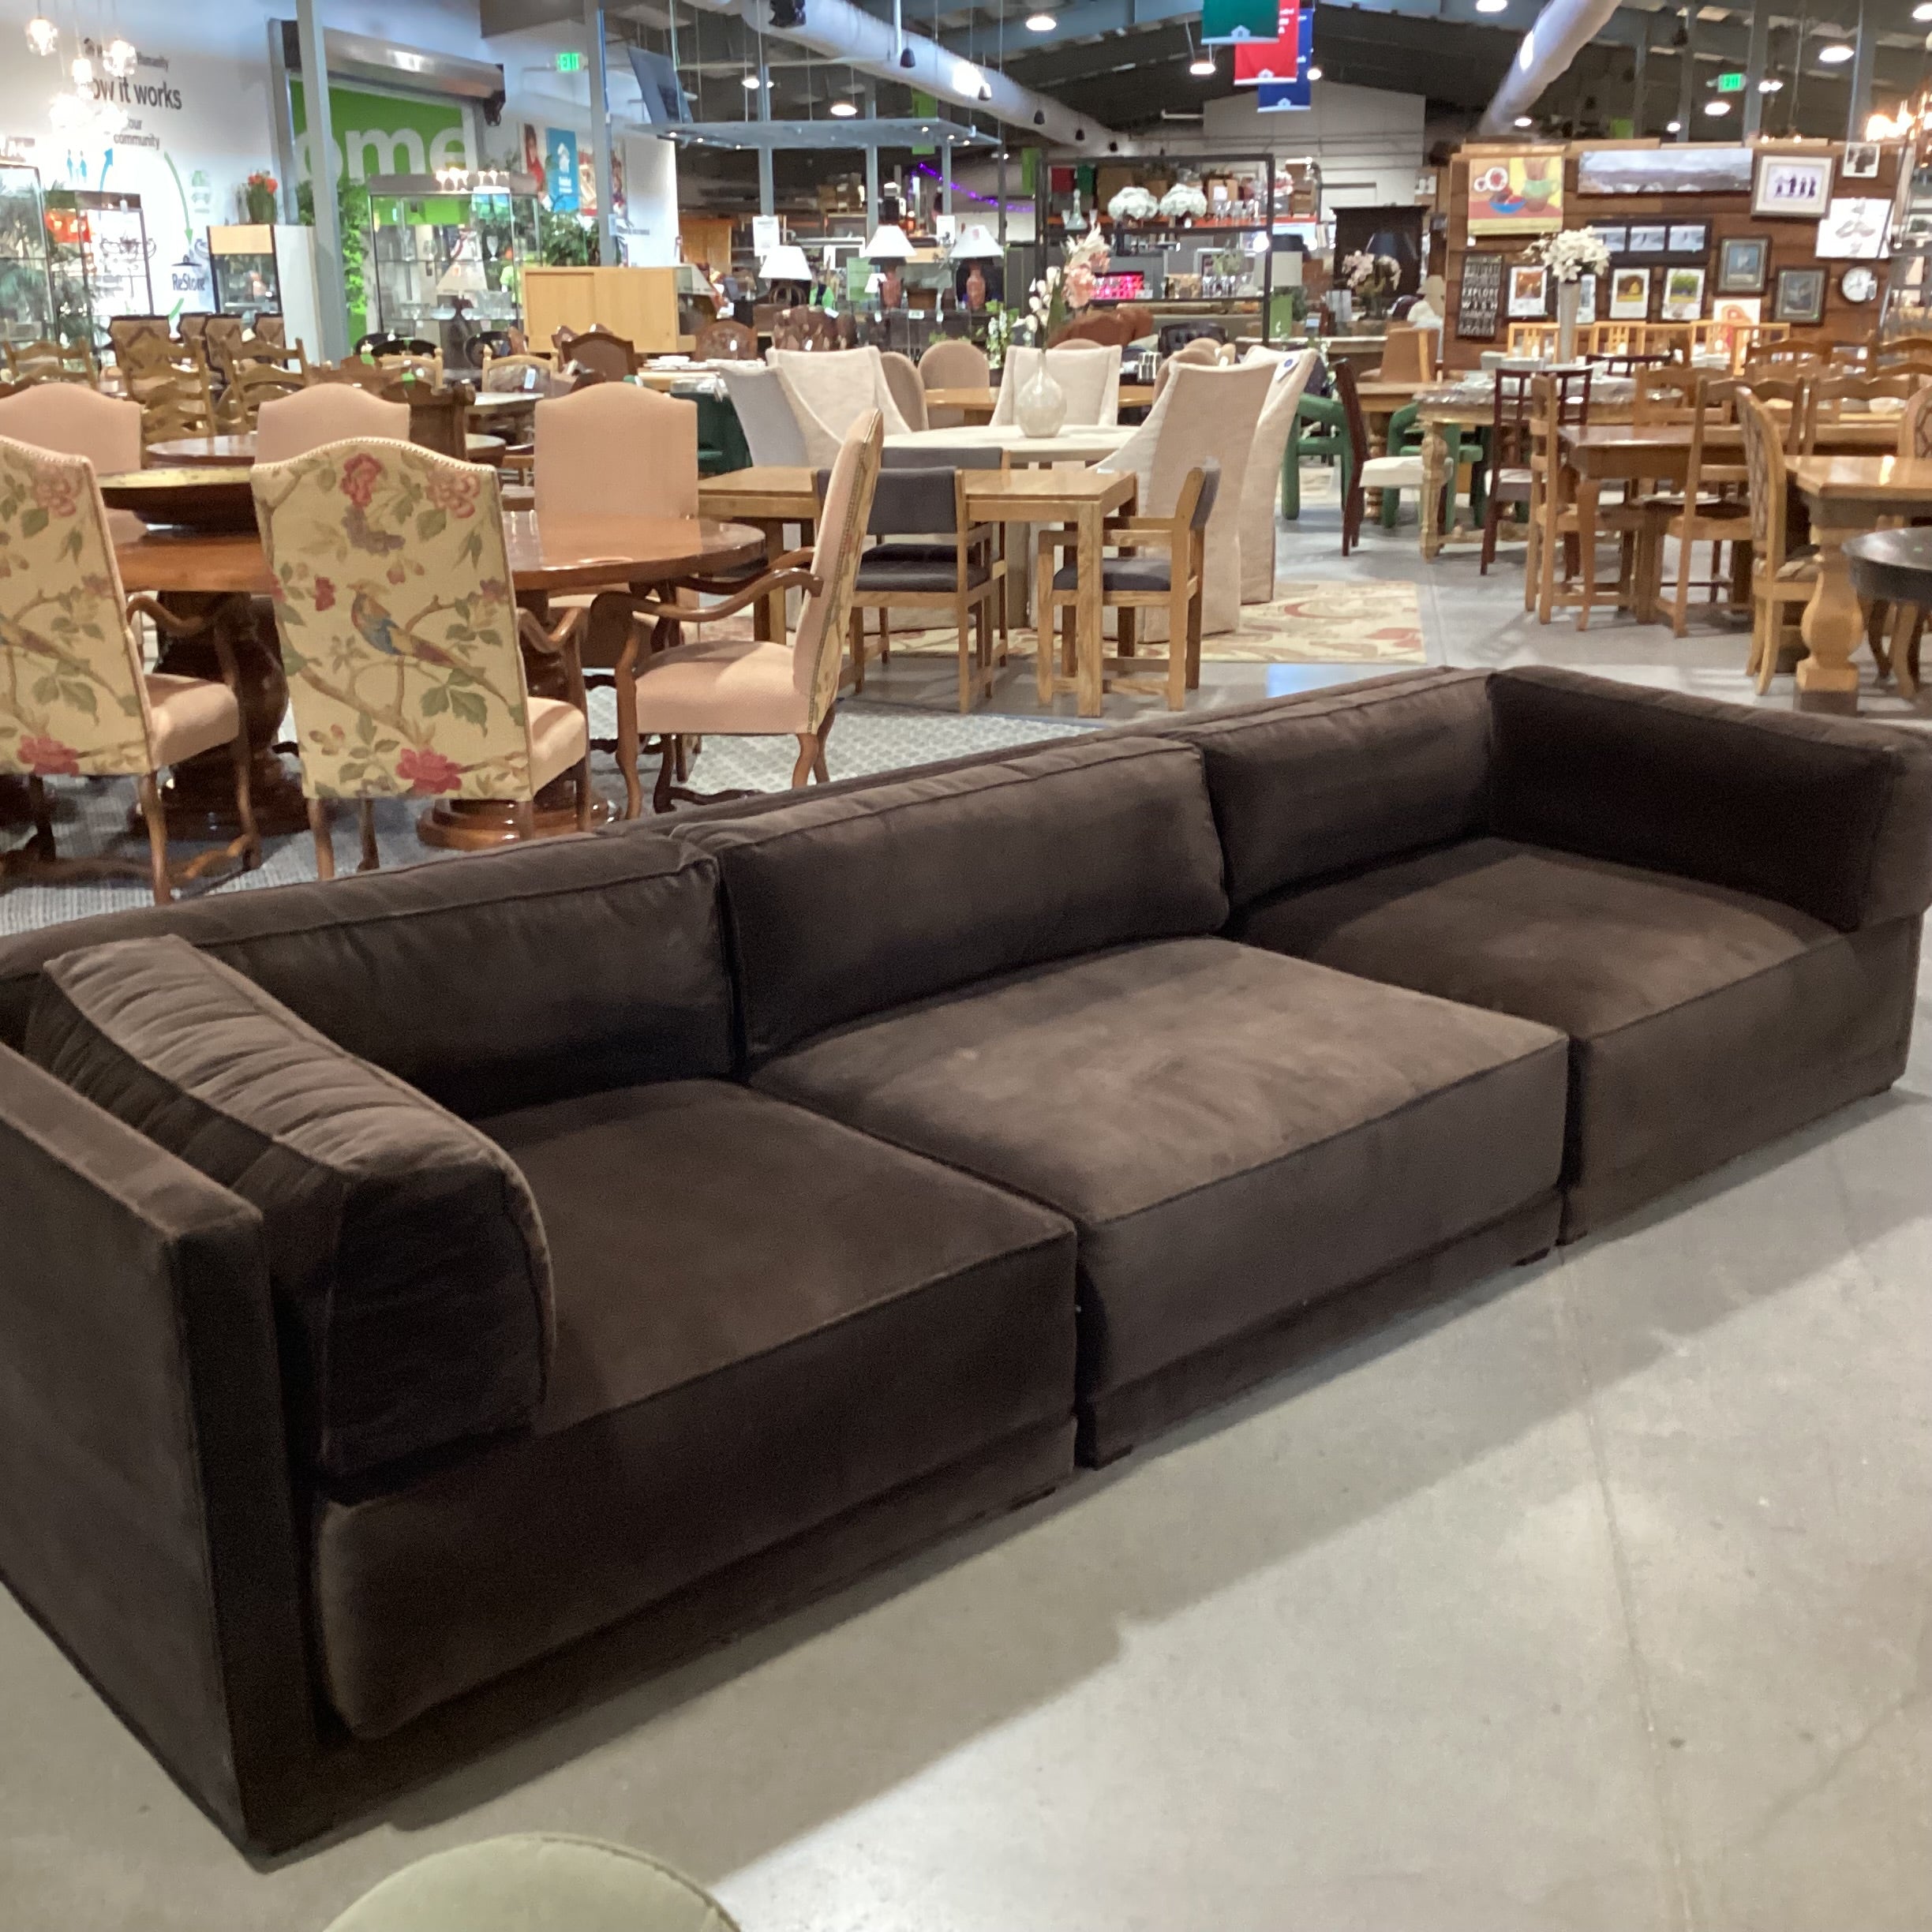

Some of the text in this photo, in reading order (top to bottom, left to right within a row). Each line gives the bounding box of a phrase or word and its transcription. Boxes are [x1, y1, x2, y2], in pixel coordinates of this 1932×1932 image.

[92, 76, 182, 110] ow it works
[113, 133, 160, 151] community
[171, 272, 206, 291] ReStore
